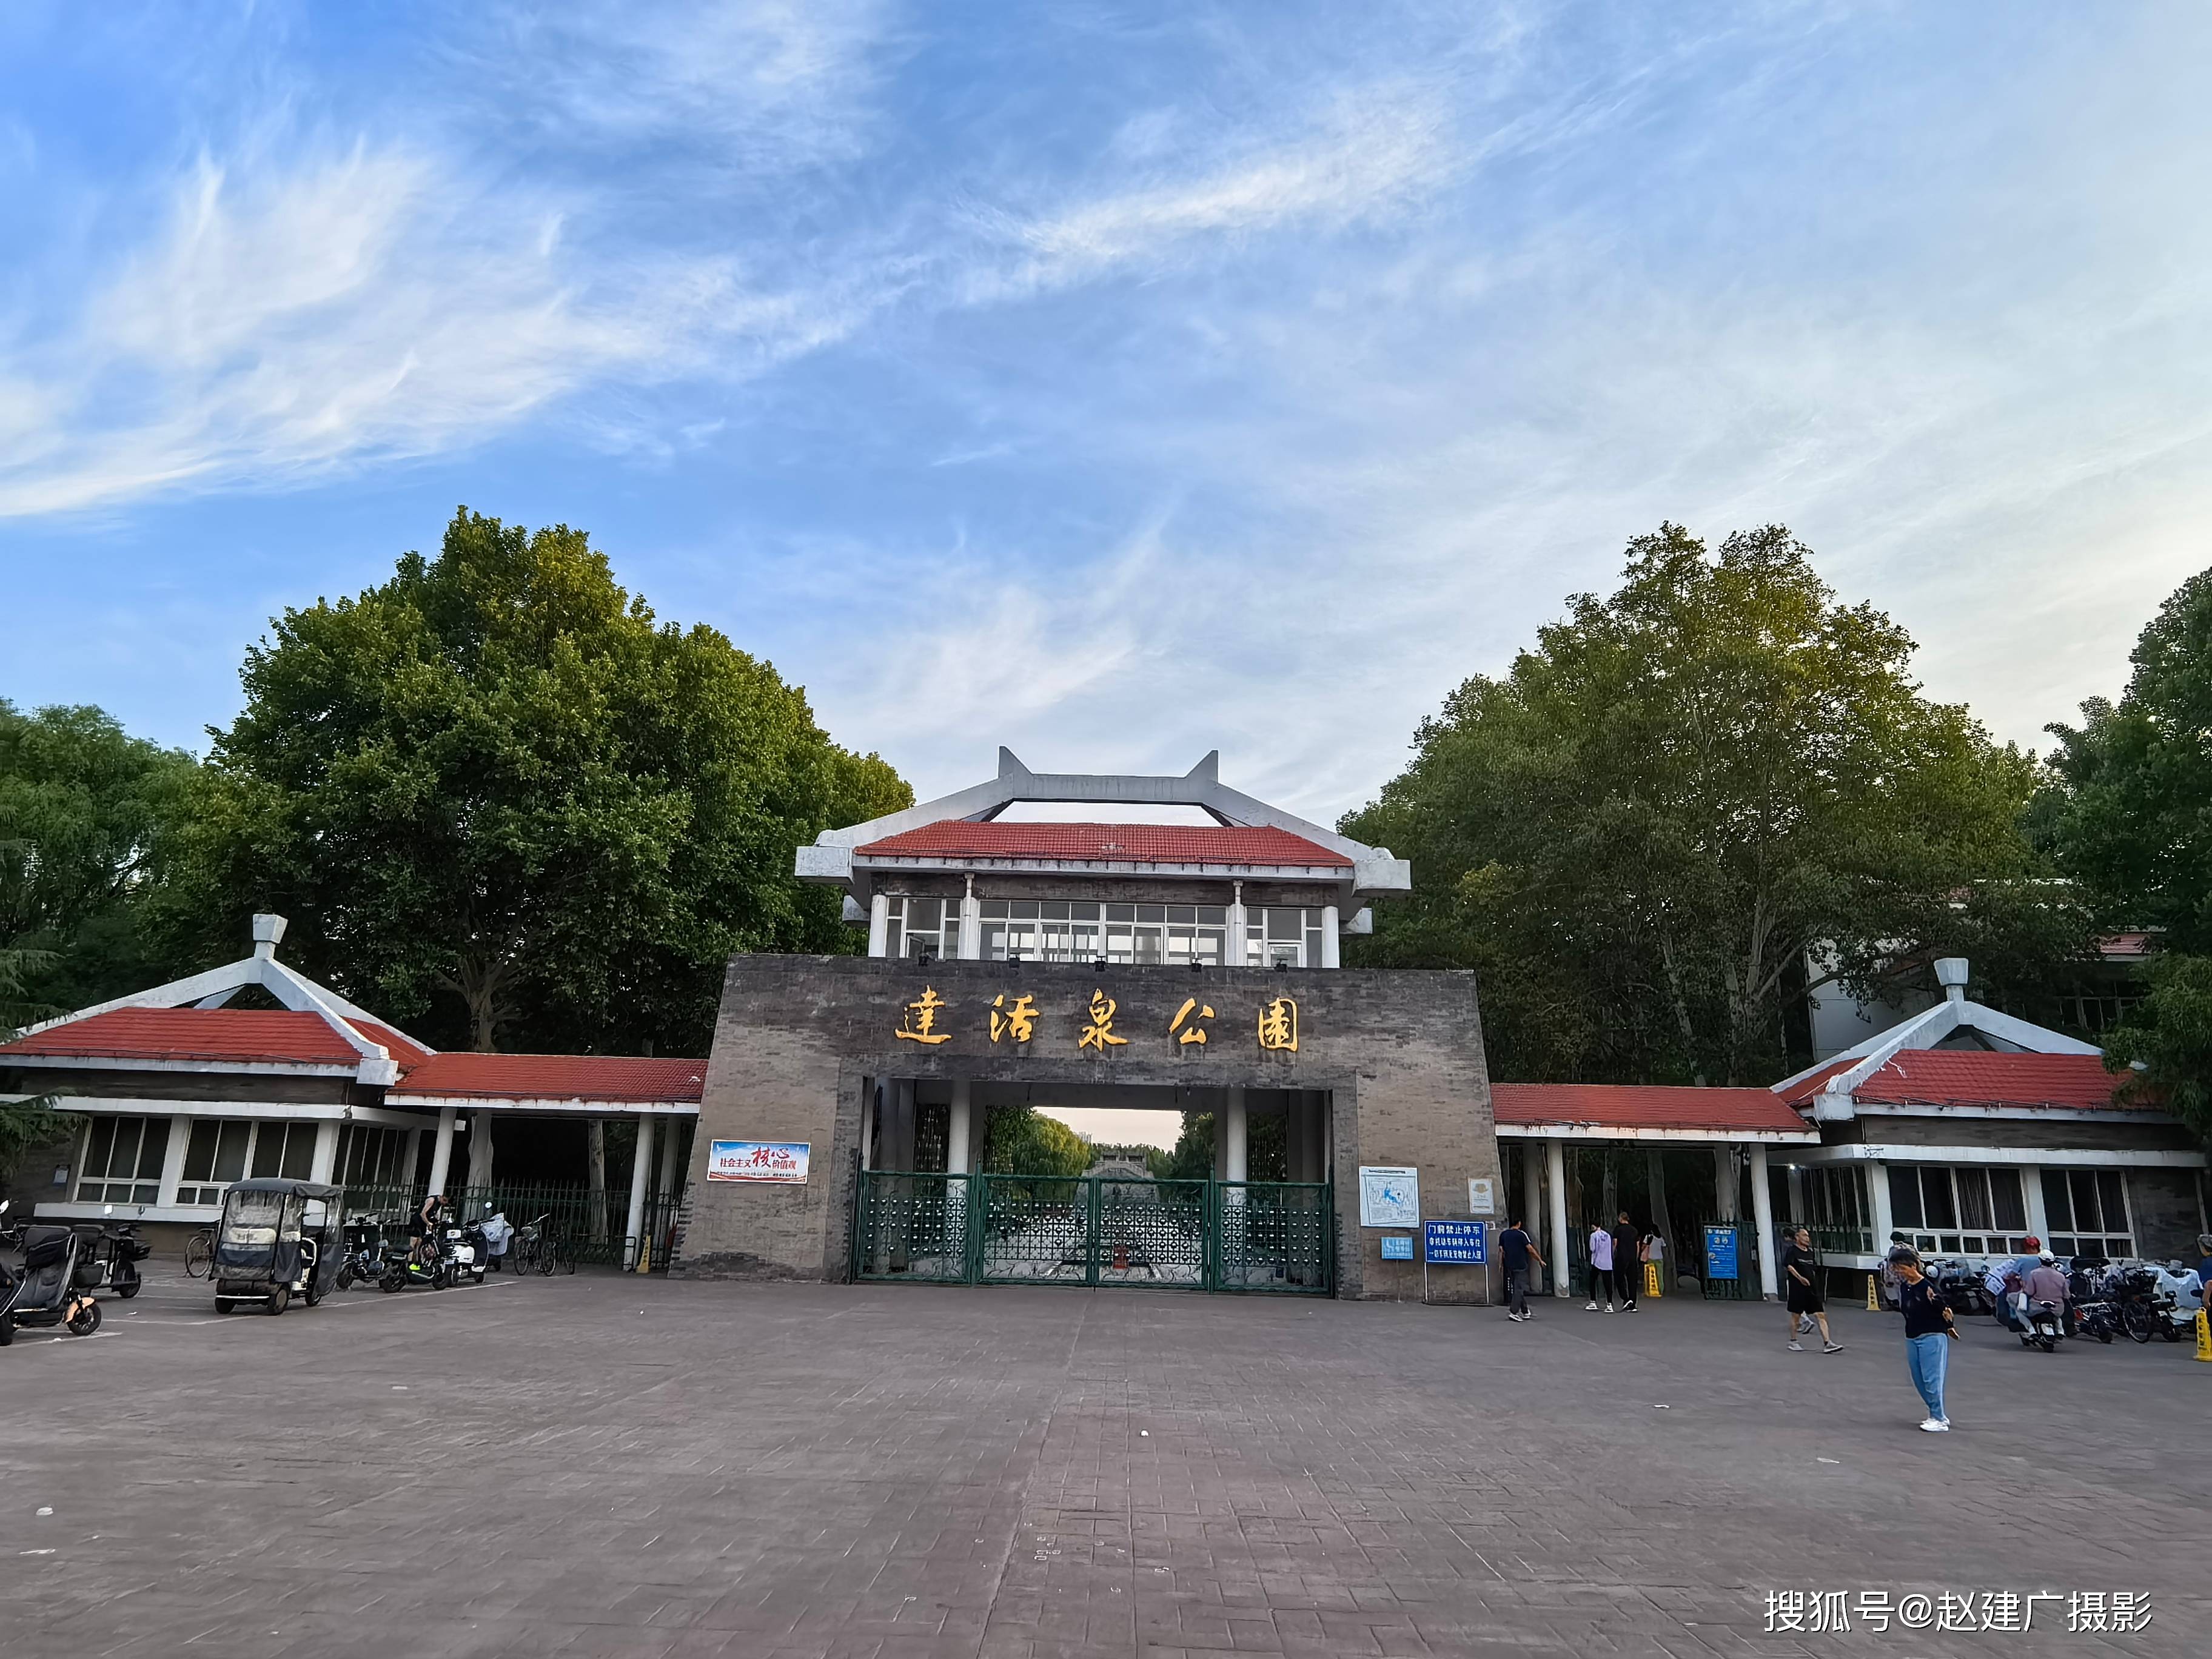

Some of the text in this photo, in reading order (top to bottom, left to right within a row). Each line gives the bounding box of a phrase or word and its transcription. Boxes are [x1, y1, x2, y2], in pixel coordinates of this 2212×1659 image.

[720, 1157, 751, 1168] 社会主义
[751, 1146, 789, 1168] 核心
[772, 1159, 797, 1170] 价值观
[1428, 1225, 1480, 1235] 门前禁止停车
